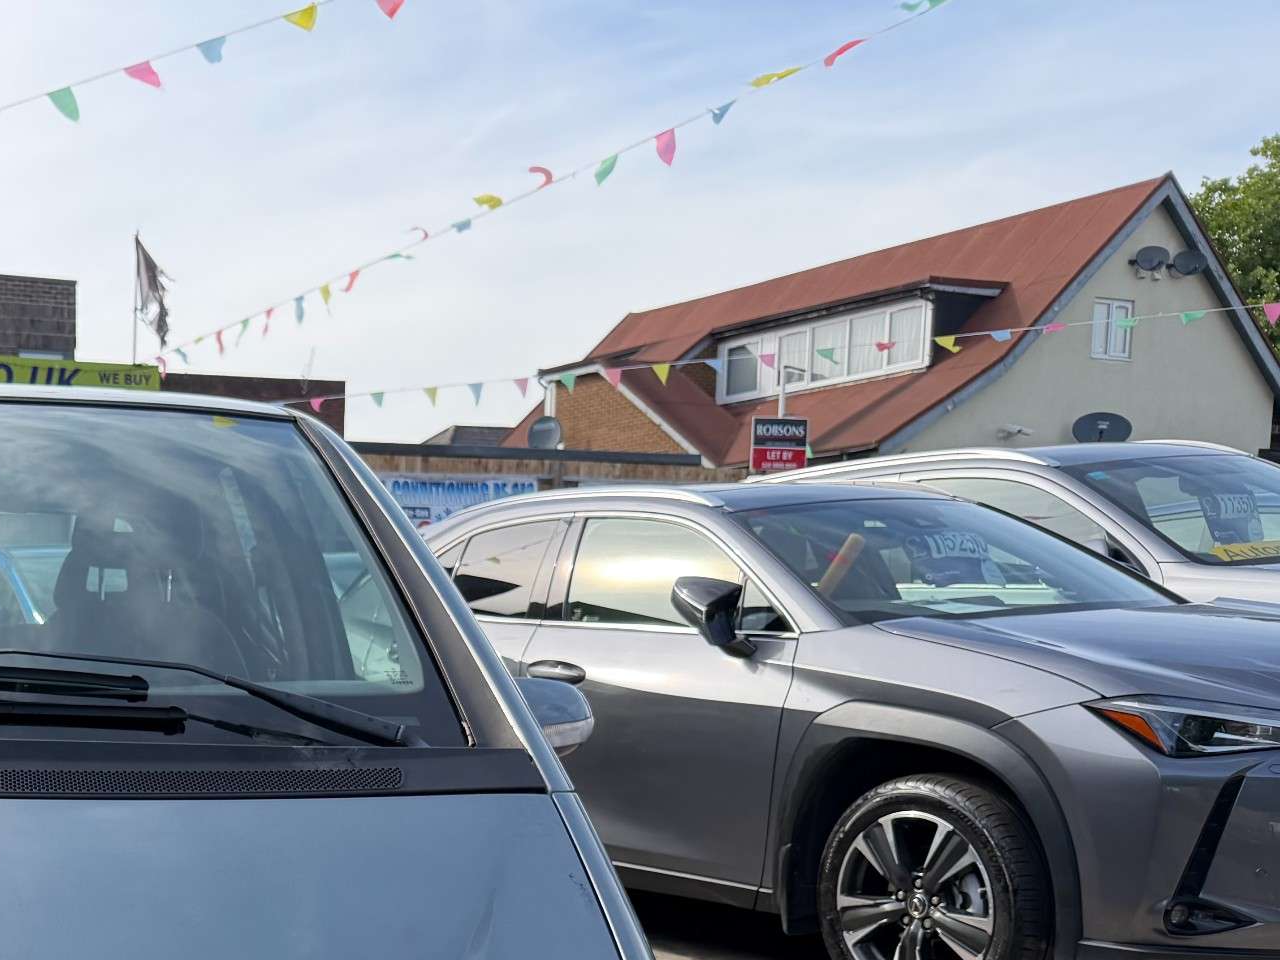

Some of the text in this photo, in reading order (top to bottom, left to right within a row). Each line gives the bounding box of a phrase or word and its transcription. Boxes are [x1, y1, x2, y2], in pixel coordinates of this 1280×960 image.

[98, 372, 151, 386] WE BUY
[766, 450, 780, 460] LET
